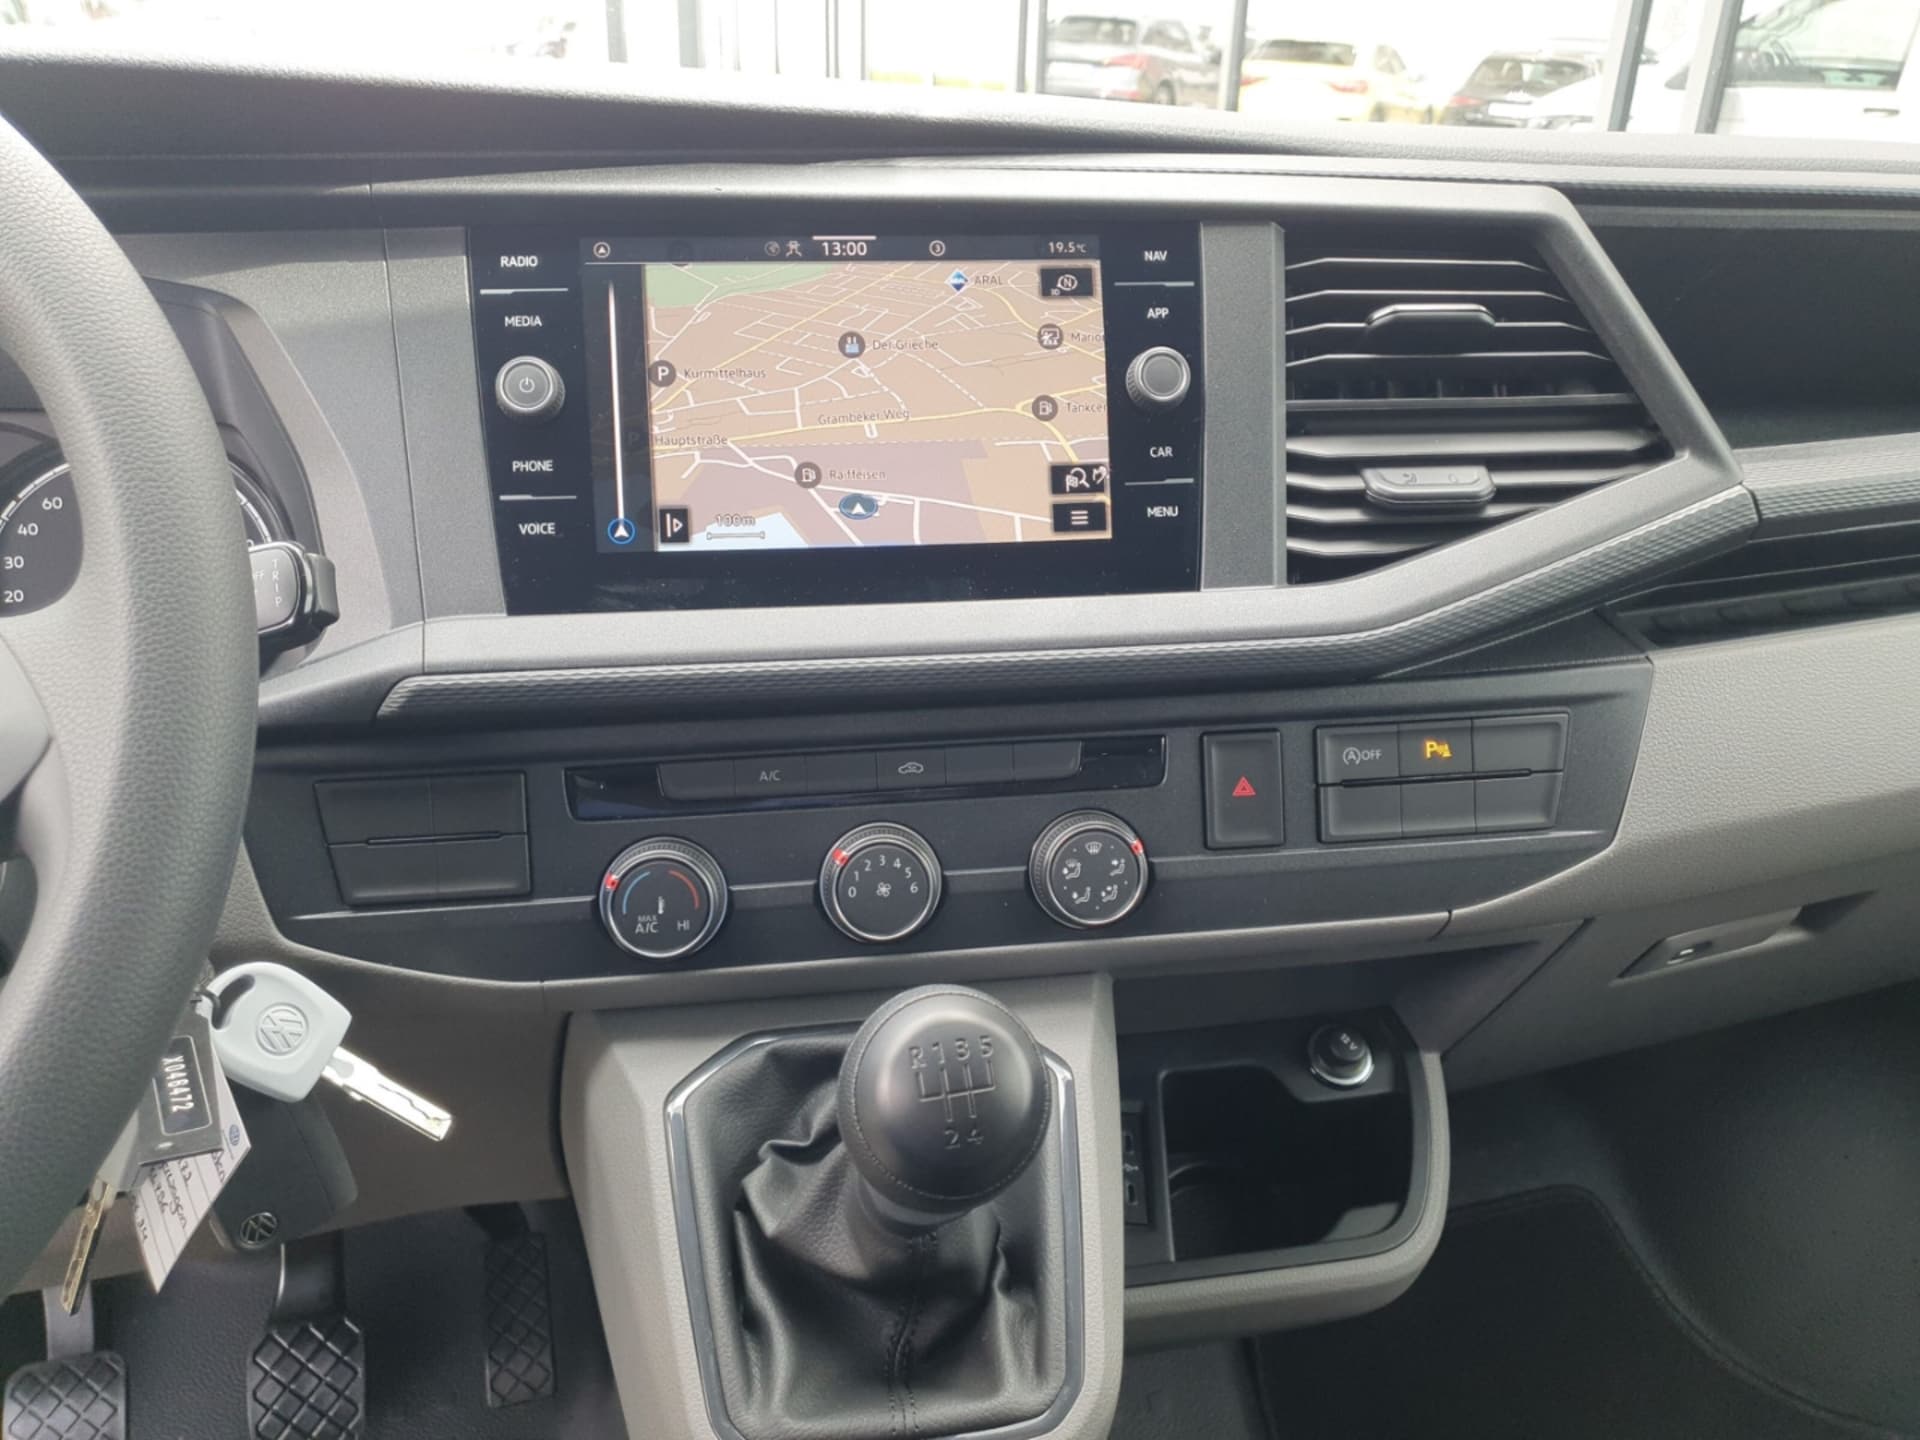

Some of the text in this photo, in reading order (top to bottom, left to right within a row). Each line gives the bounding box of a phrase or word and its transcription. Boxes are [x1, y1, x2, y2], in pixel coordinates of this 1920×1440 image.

[822, 242, 868, 256] 13:00
[500, 255, 538, 267] RADIO
[1144, 250, 1169, 262] NAV
[974, 275, 1003, 286] ARAL
[1147, 307, 1169, 319] APP
[504, 315, 543, 328] MEDIA
[872, 339, 938, 351] Der Grieche
[684, 367, 767, 380] Kurmittelhaus
[818, 409, 910, 425] Grambeker Weg
[654, 434, 728, 447] Hauptstraße
[1150, 446, 1173, 458] CAR
[512, 460, 554, 473] PHONE
[42, 497, 62, 509] 60
[1147, 506, 1179, 518] MENU
[17, 523, 38, 536] 40
[519, 522, 556, 535] VOICE
[4, 556, 24, 569] 30
[4, 590, 24, 602] 20
[1361, 749, 1382, 761] OFF
[759, 770, 781, 782] A/C
[864, 860, 873, 872] 2
[879, 855, 887, 867] 3
[892, 858, 901, 870] 4
[854, 870, 860, 882] 1
[904, 867, 912, 879] 5
[848, 886, 857, 899] 0
[910, 882, 919, 894] 6
[635, 921, 660, 934] A/C
[677, 920, 690, 931] HI
[909, 1035, 994, 1069] R 1 3 5
[944, 1128, 985, 1149] 2 4
